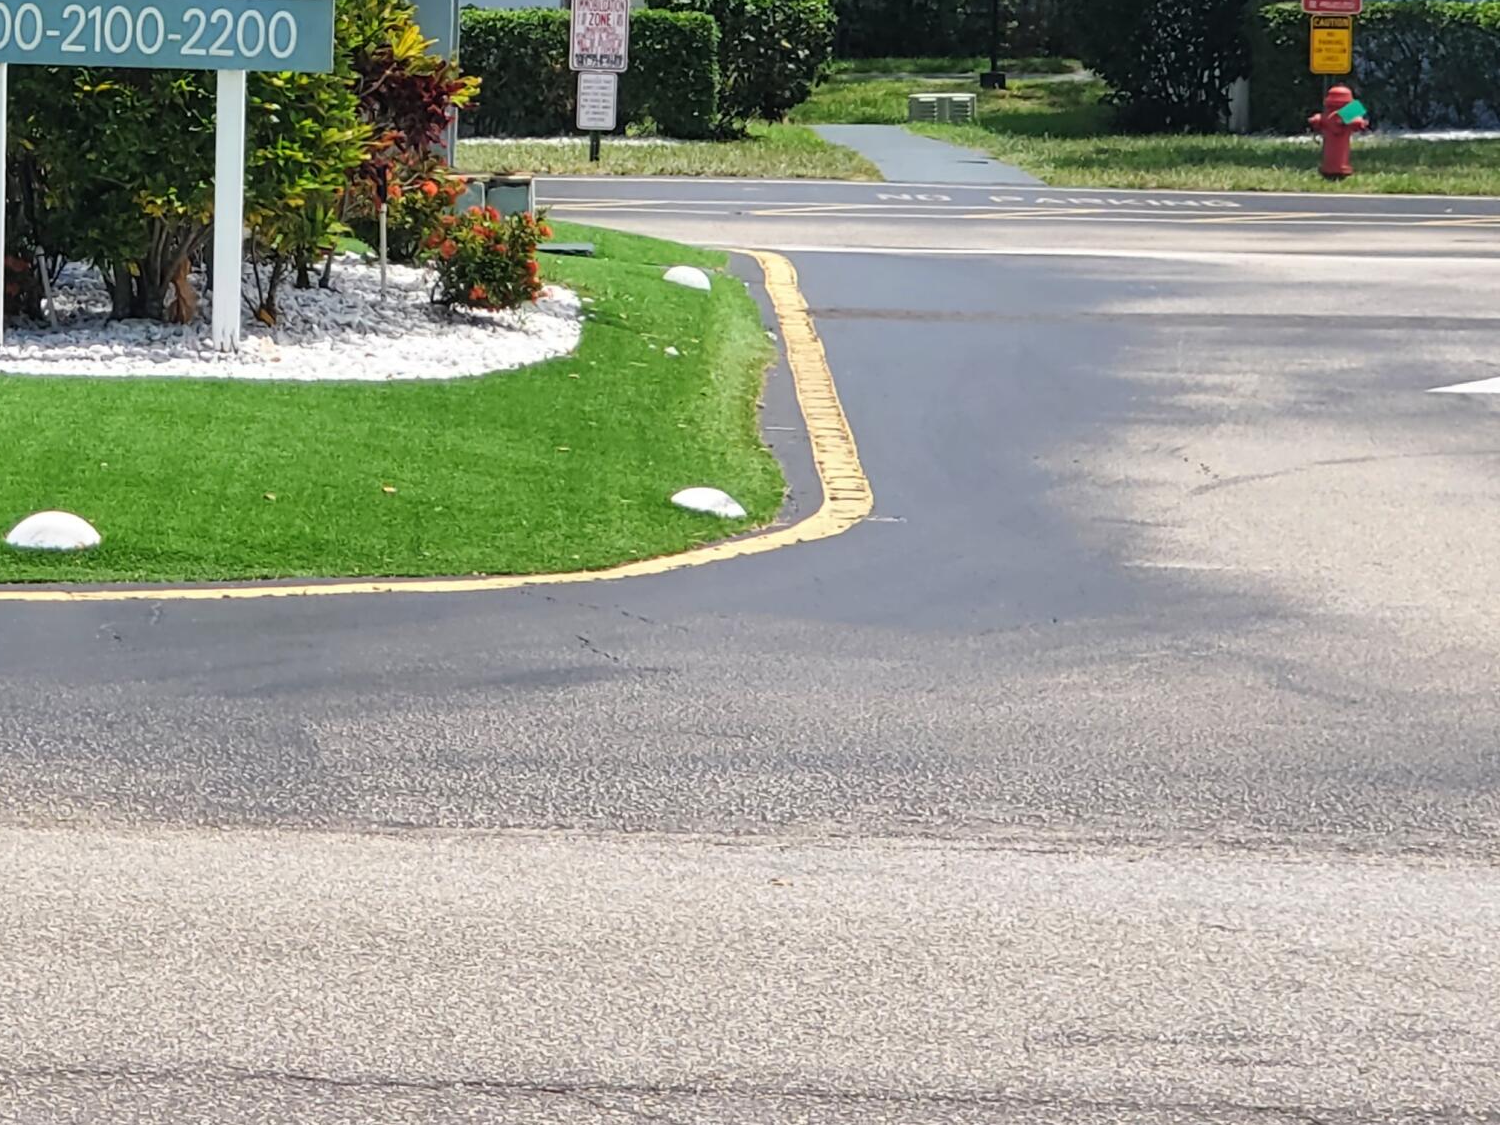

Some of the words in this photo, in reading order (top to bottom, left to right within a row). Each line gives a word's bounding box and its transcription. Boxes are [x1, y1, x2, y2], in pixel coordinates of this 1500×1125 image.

[589, 12, 612, 27] ZONE
[1314, 18, 1349, 27] CAUTION
[876, 193, 952, 202] NO
[988, 194, 1241, 208] PARKING
